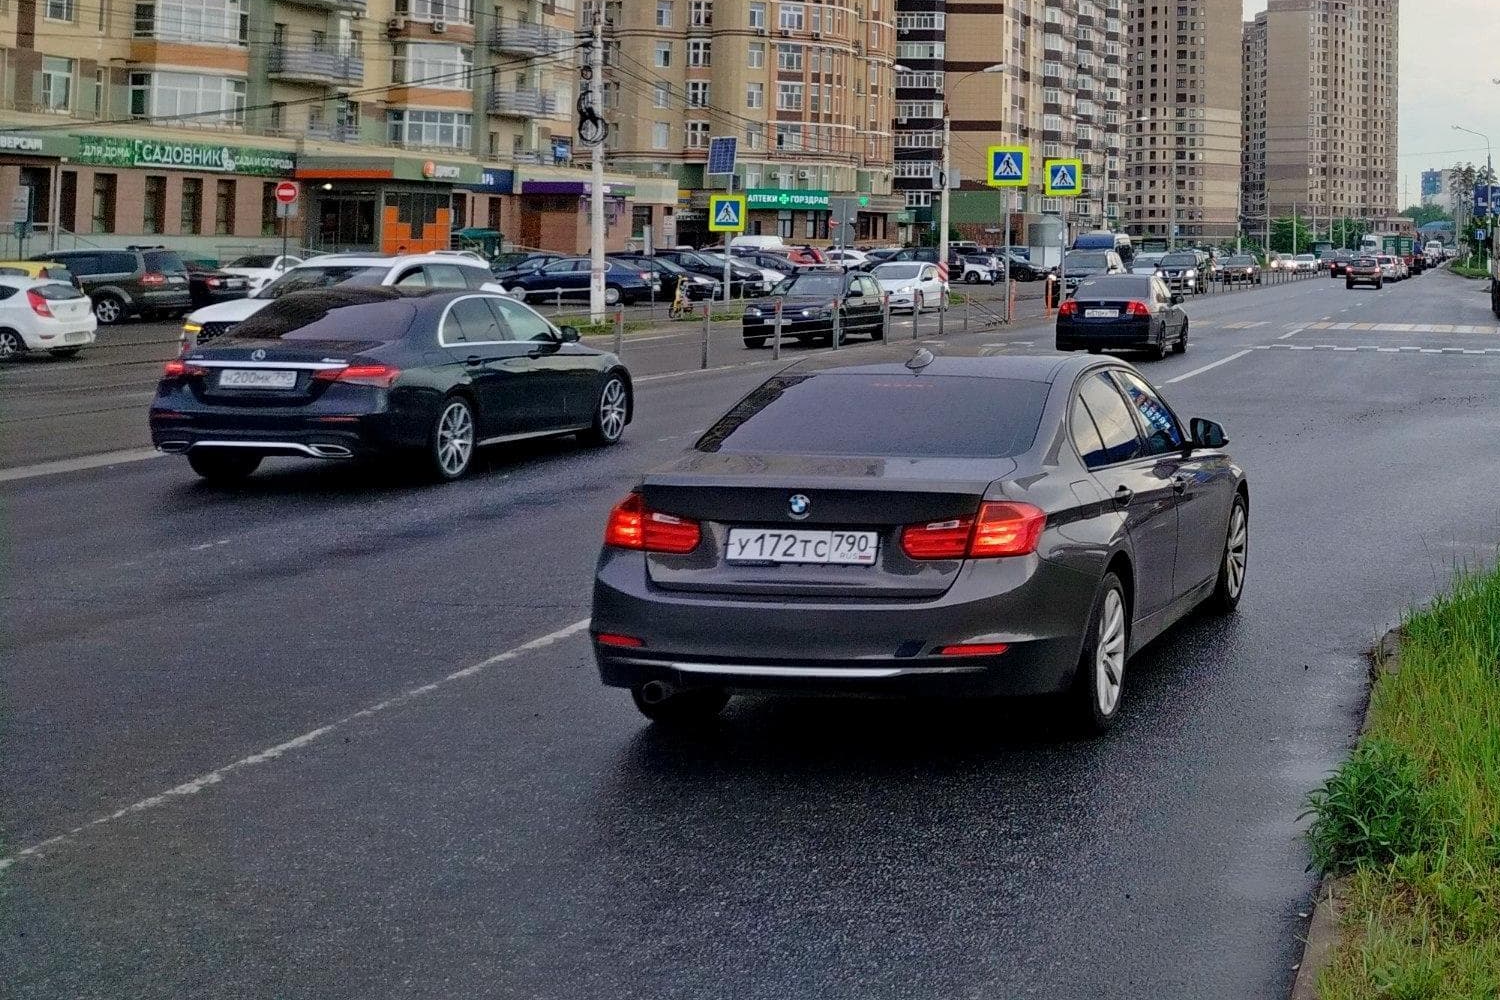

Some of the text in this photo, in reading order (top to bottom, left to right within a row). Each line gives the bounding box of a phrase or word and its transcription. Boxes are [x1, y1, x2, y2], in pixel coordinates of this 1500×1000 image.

[83, 144, 101, 156] ДЛЯ
[143, 144, 223, 166] САДОВНИК
[747, 194, 778, 203] АПТЕКИ
[834, 534, 870, 552] 790
